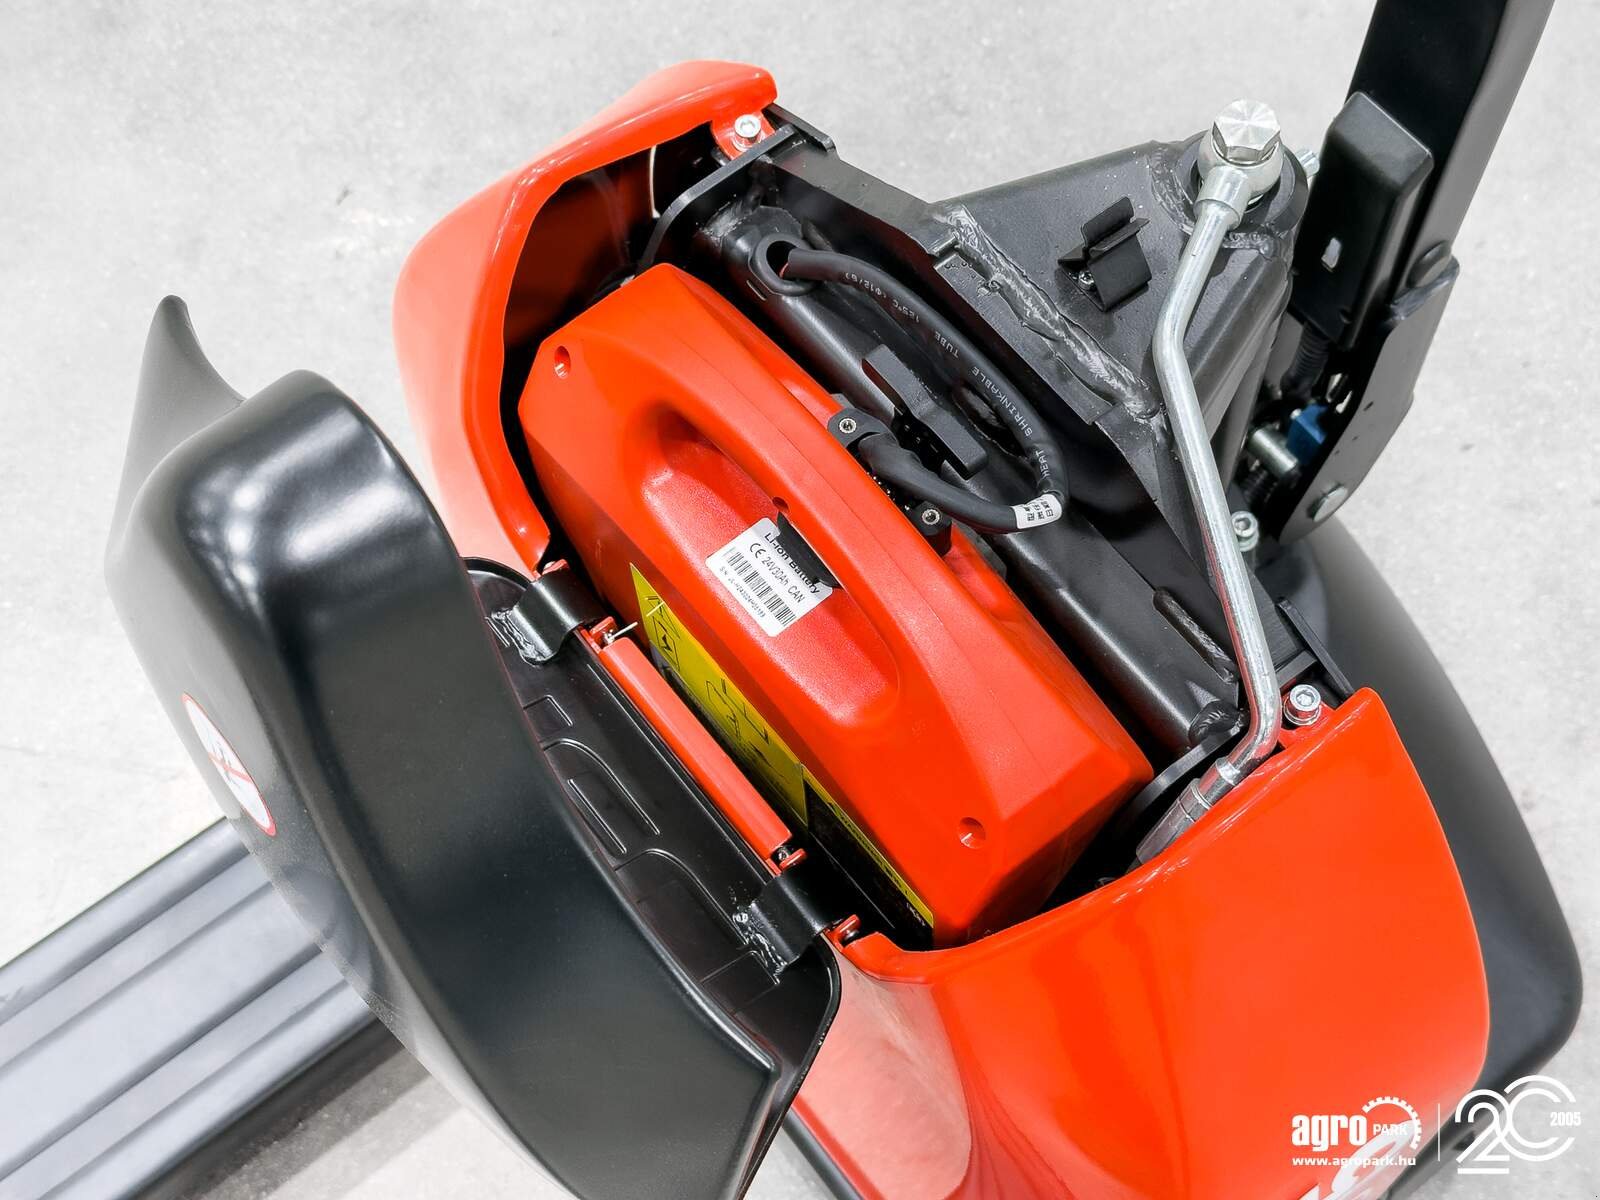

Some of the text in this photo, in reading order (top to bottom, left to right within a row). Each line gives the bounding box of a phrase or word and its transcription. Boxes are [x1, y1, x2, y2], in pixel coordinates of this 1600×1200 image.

[933, 330, 959, 358] TUBE
[971, 365, 1033, 438] SHRINKABLE
[1035, 450, 1054, 478] HEAT
[762, 556, 789, 586] 24V30Ah
[788, 585, 806, 603] CAN
[789, 560, 821, 594] Battery
